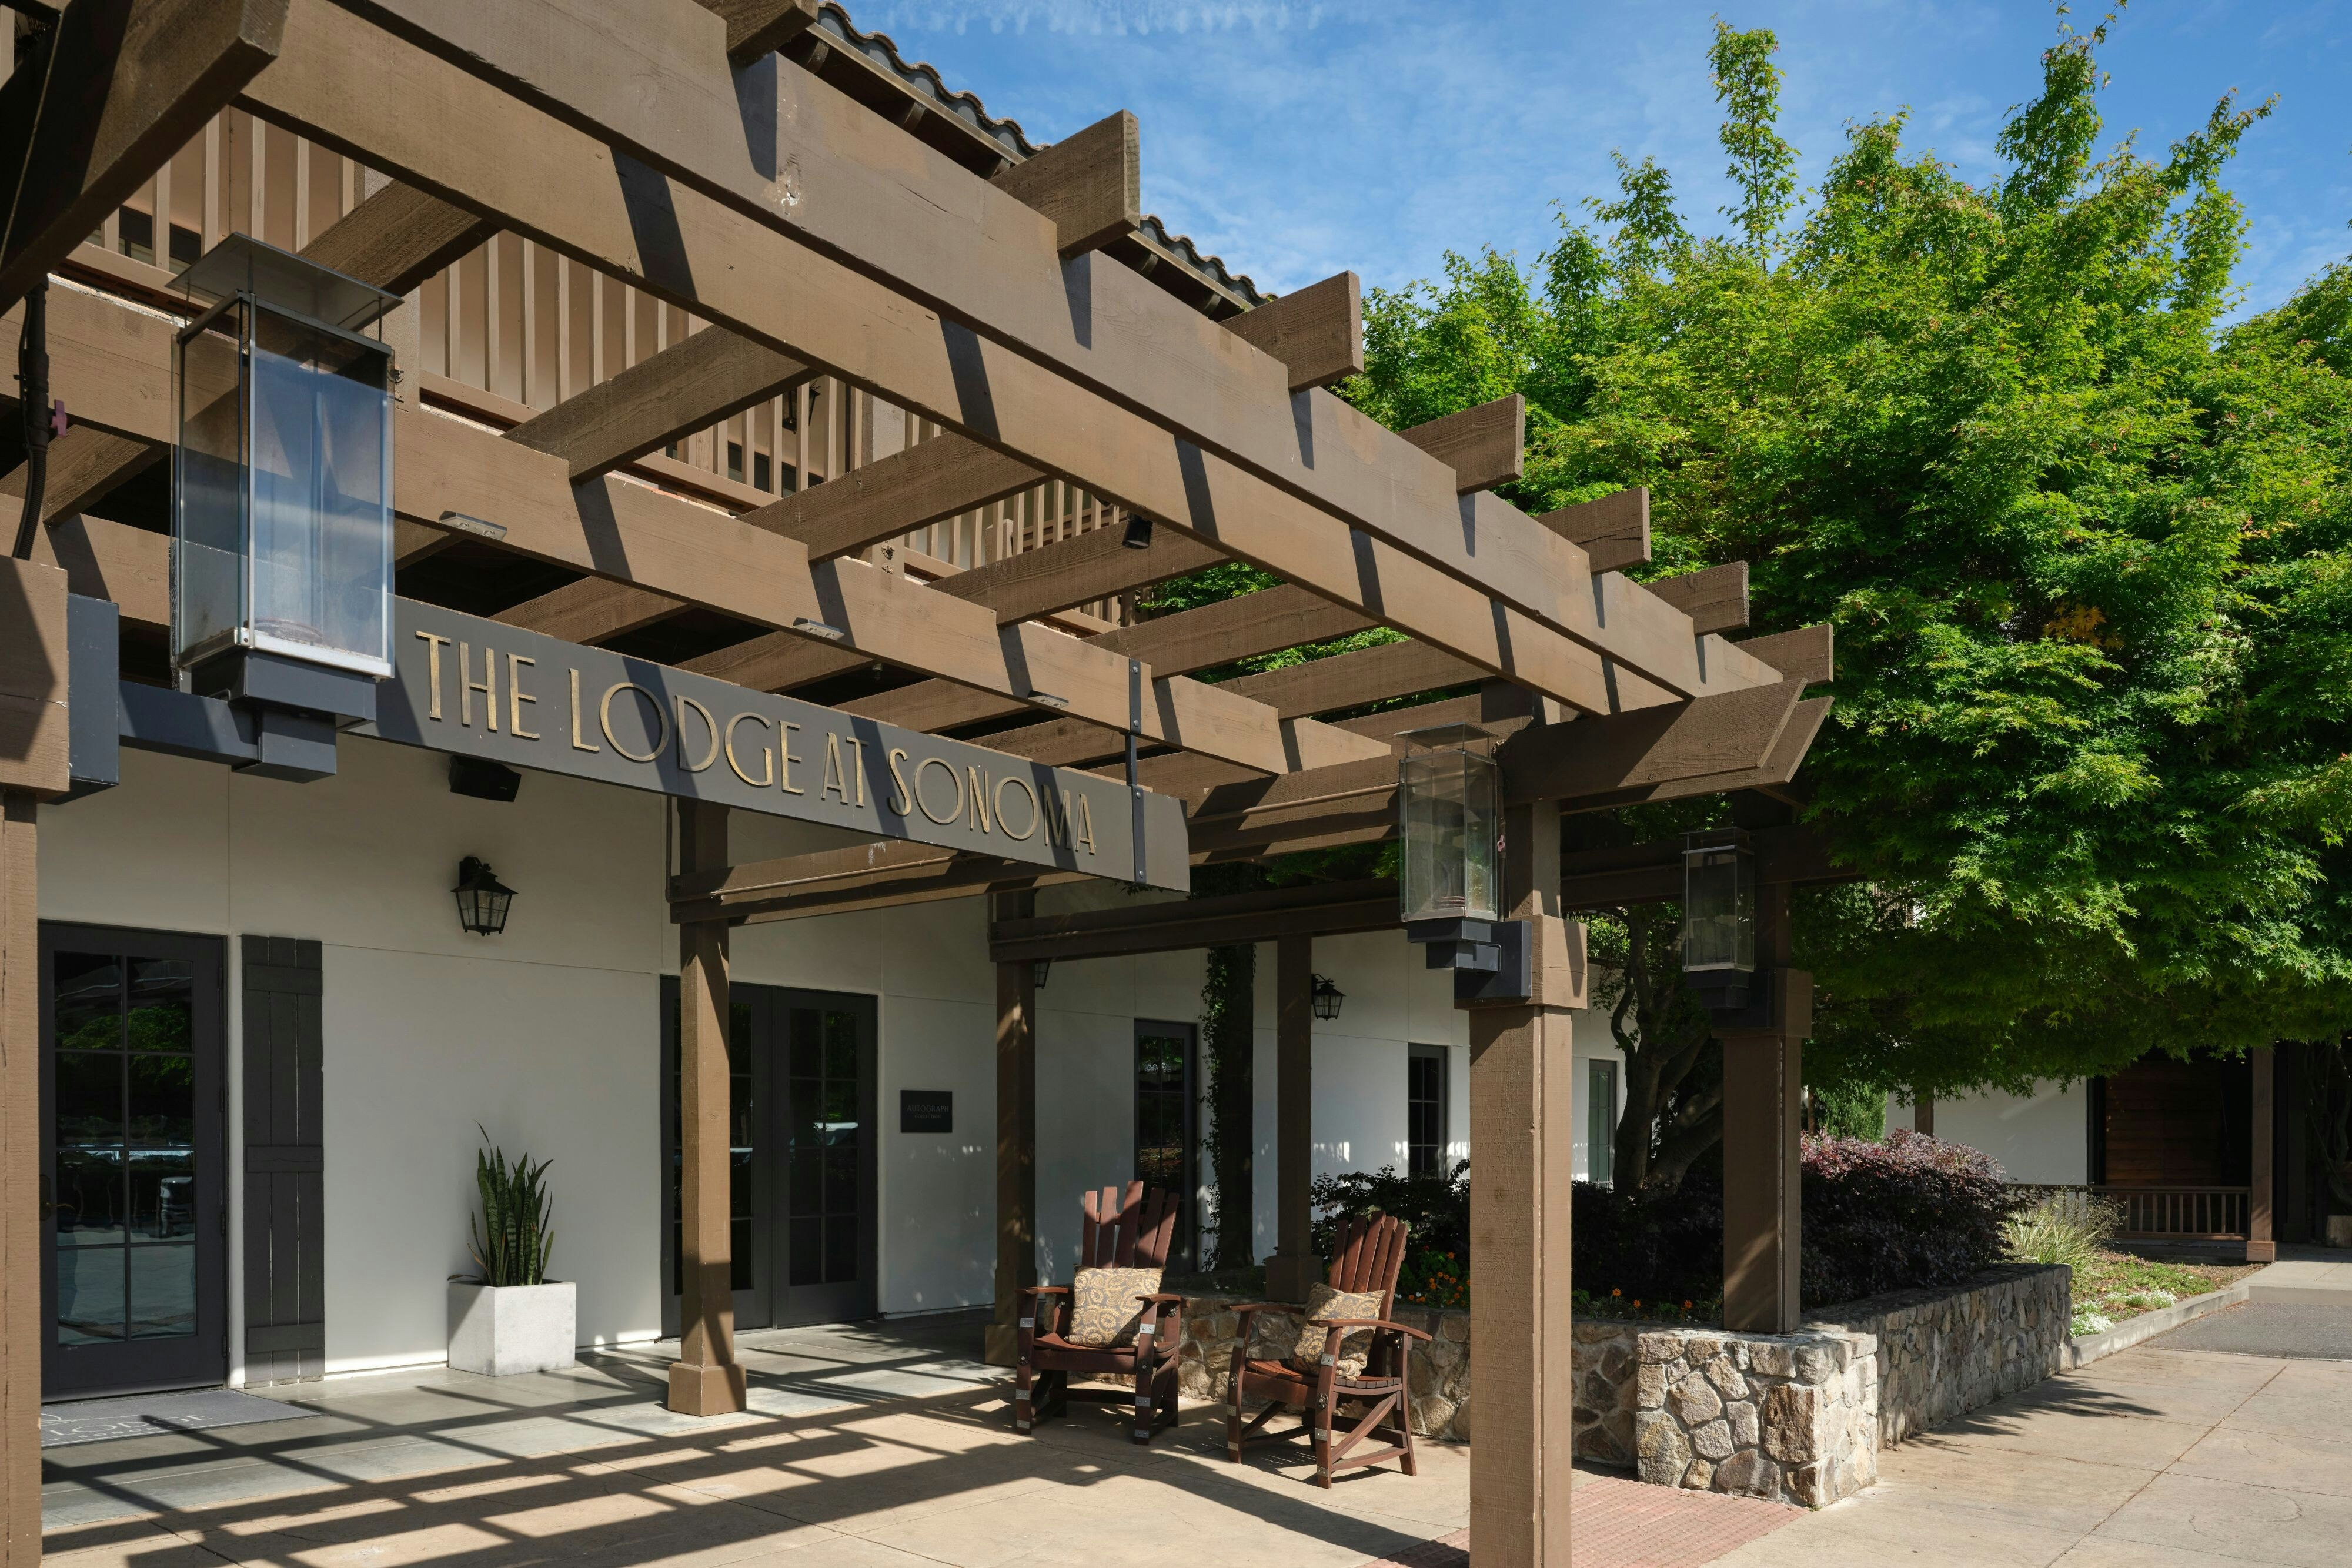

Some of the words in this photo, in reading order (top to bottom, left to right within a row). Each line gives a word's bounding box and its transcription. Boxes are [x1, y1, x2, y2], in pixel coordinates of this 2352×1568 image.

[415, 630, 540, 741] THE
[569, 668, 804, 795] LODGE
[821, 733, 869, 808] AT
[887, 747, 1096, 855] SONOMA
[49, 1415, 212, 1436] LODGE
